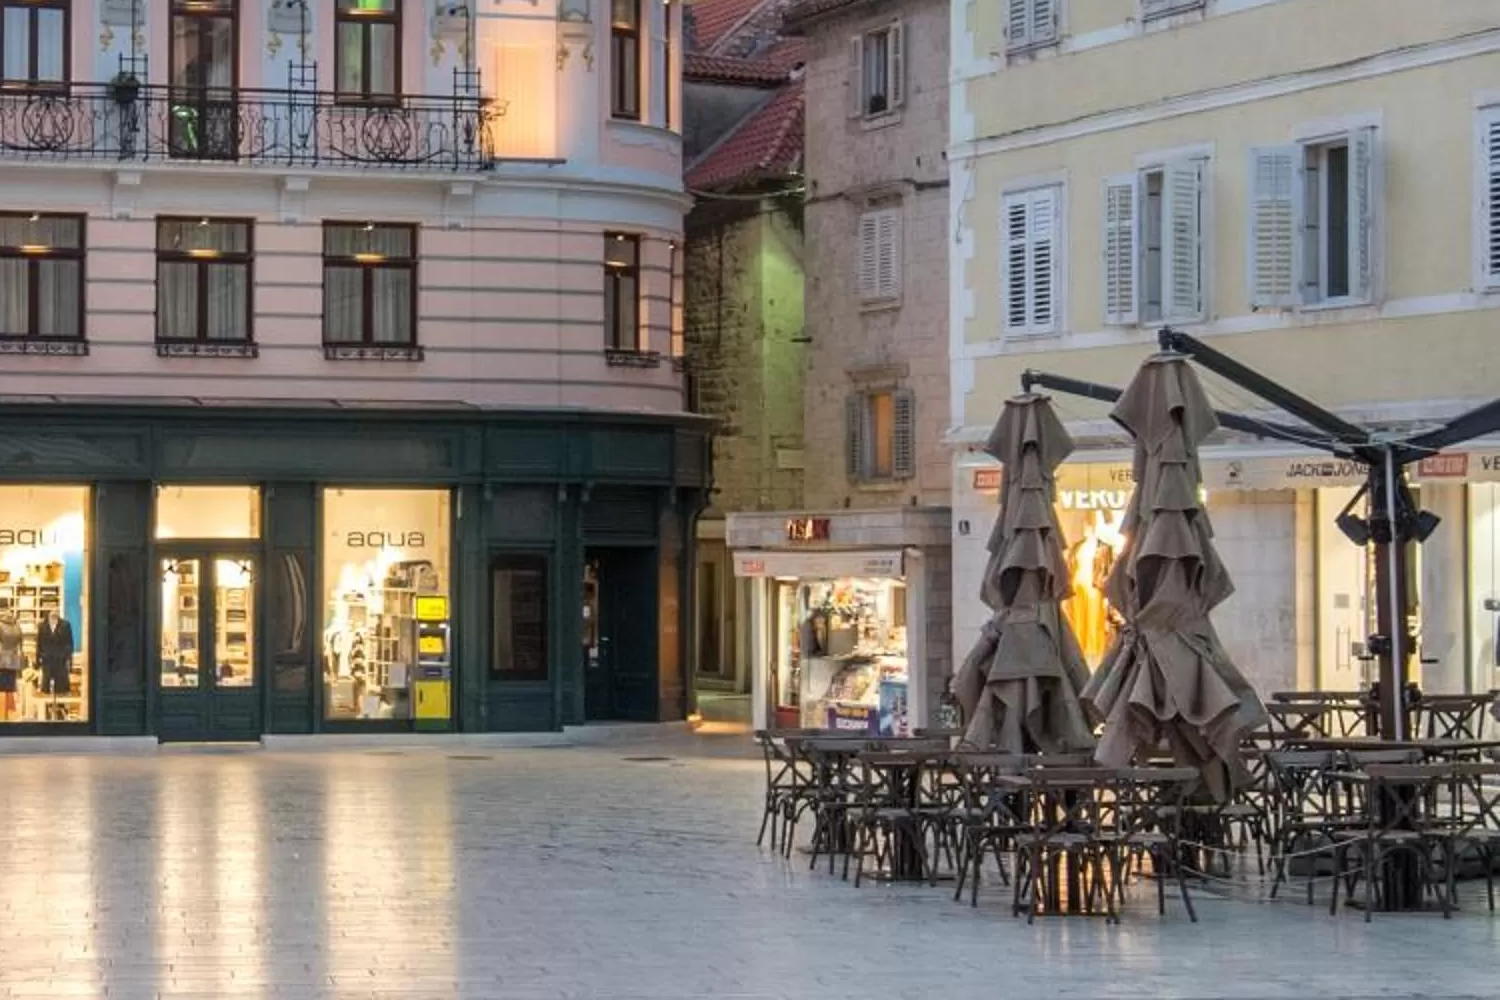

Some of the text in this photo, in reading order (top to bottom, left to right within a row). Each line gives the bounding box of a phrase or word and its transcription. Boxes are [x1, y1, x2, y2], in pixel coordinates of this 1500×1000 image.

[1286, 463, 1321, 477] JACK
[1332, 461, 1372, 477] JONE
[347, 531, 425, 552] aqua
